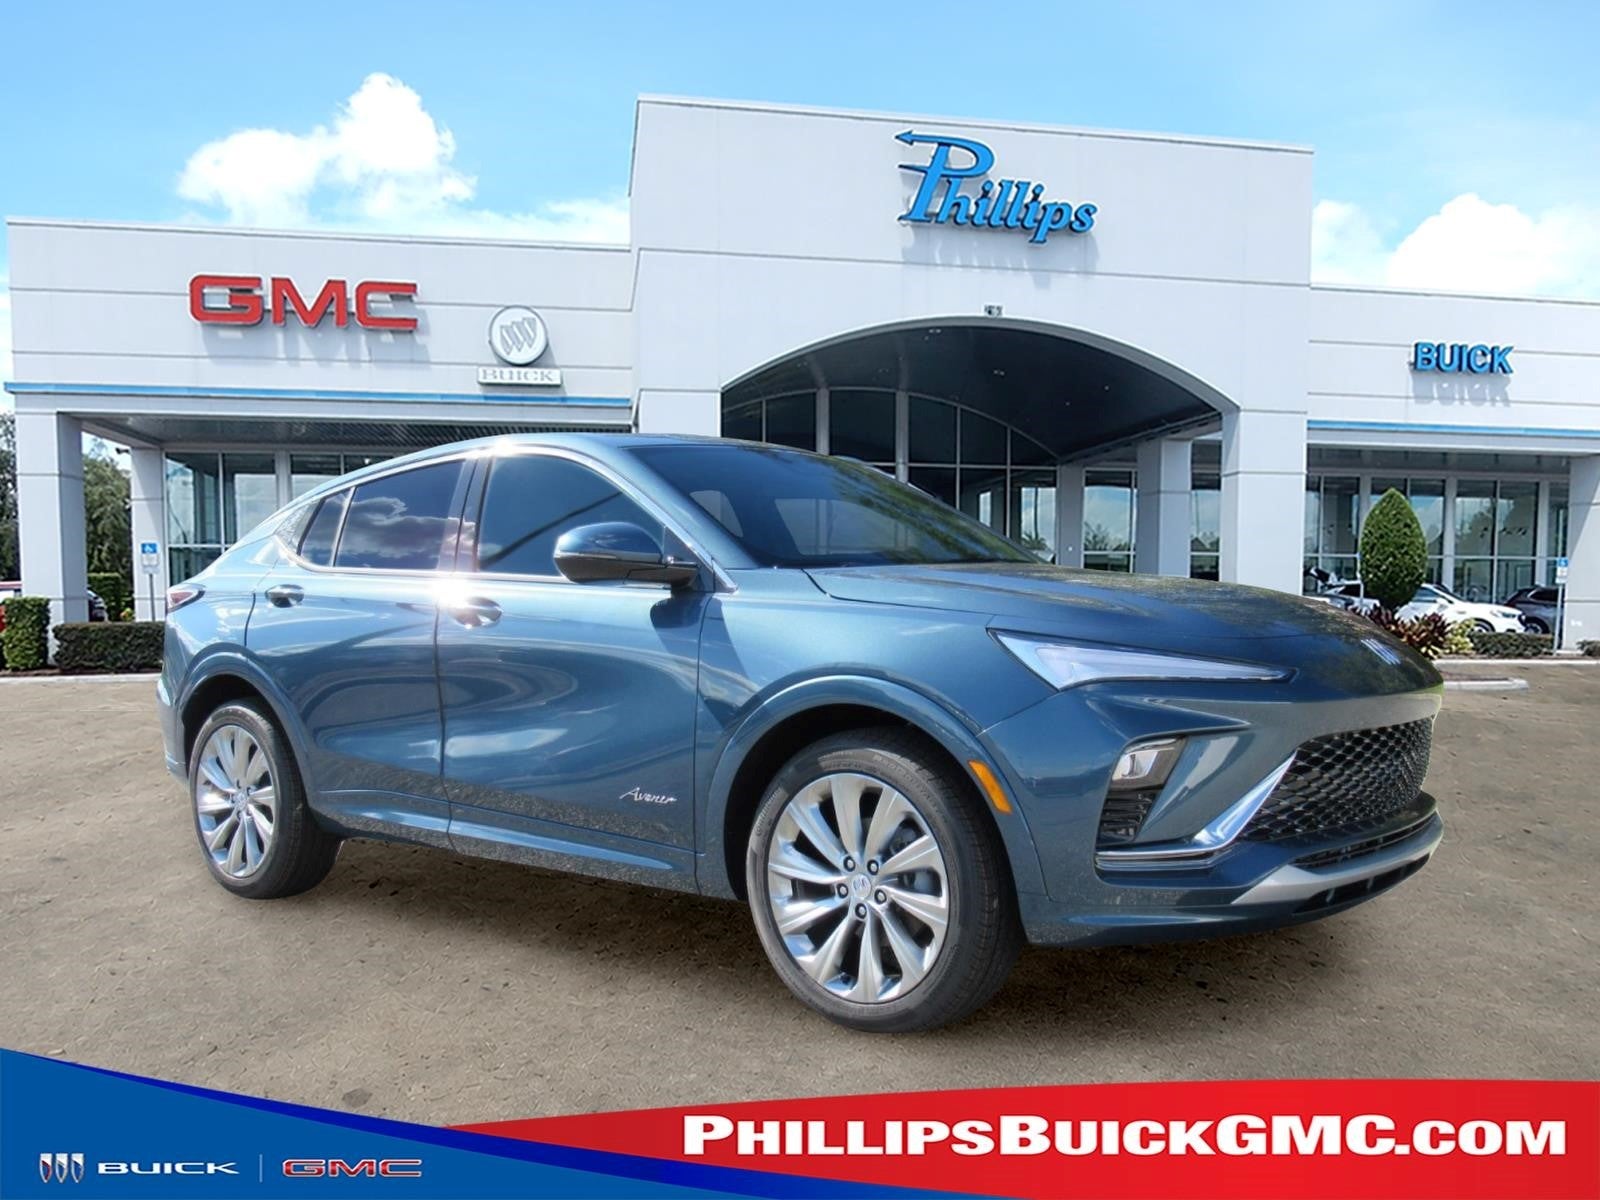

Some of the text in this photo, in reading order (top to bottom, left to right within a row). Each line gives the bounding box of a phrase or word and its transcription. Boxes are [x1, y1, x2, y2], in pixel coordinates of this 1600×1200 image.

[895, 130, 1097, 243] Phillips
[189, 274, 418, 330] GMC
[482, 368, 554, 382] BUICK
[1413, 341, 1514, 374] BUICK
